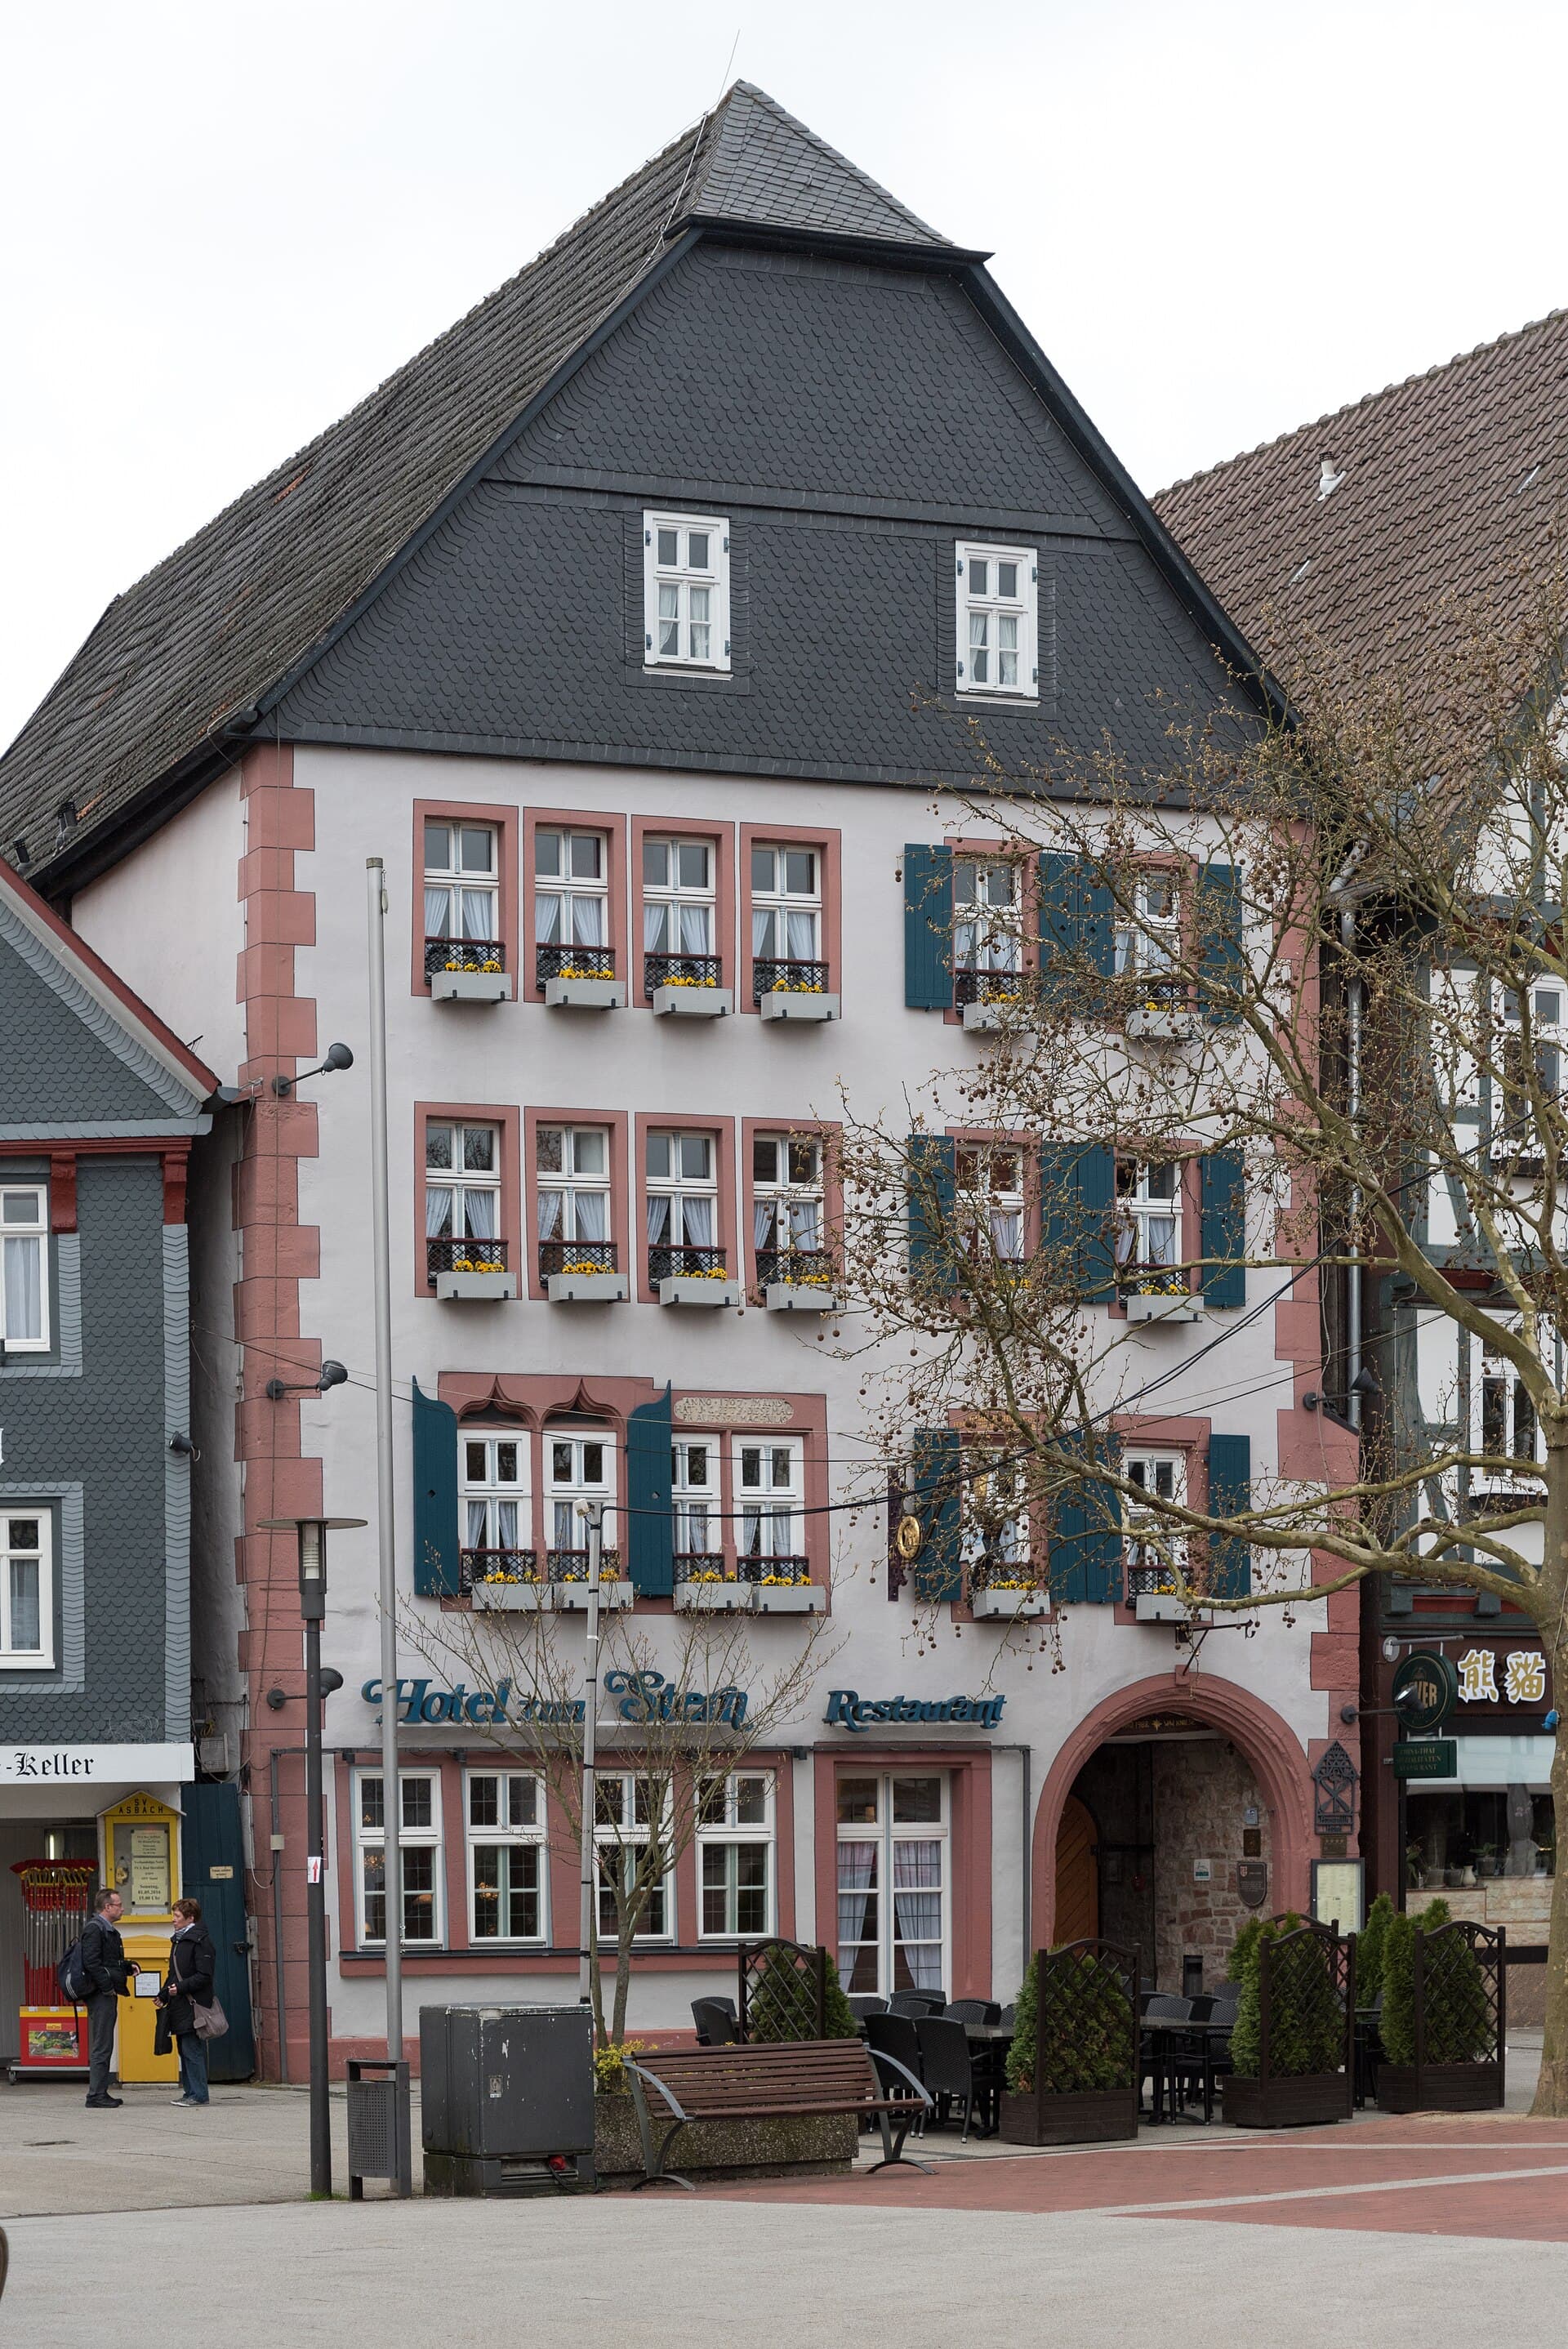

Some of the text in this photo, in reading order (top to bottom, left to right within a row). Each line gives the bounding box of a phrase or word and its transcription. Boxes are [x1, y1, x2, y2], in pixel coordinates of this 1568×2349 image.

[1458, 1650, 1546, 1705] 熊貓
[361, 1677, 512, 1724] Hotel
[604, 1670, 753, 1732] Stern
[823, 1691, 1007, 1732] Restaurant
[0, 1752, 94, 1776] -Keller
[118, 1806, 163, 1814] ASBACH
